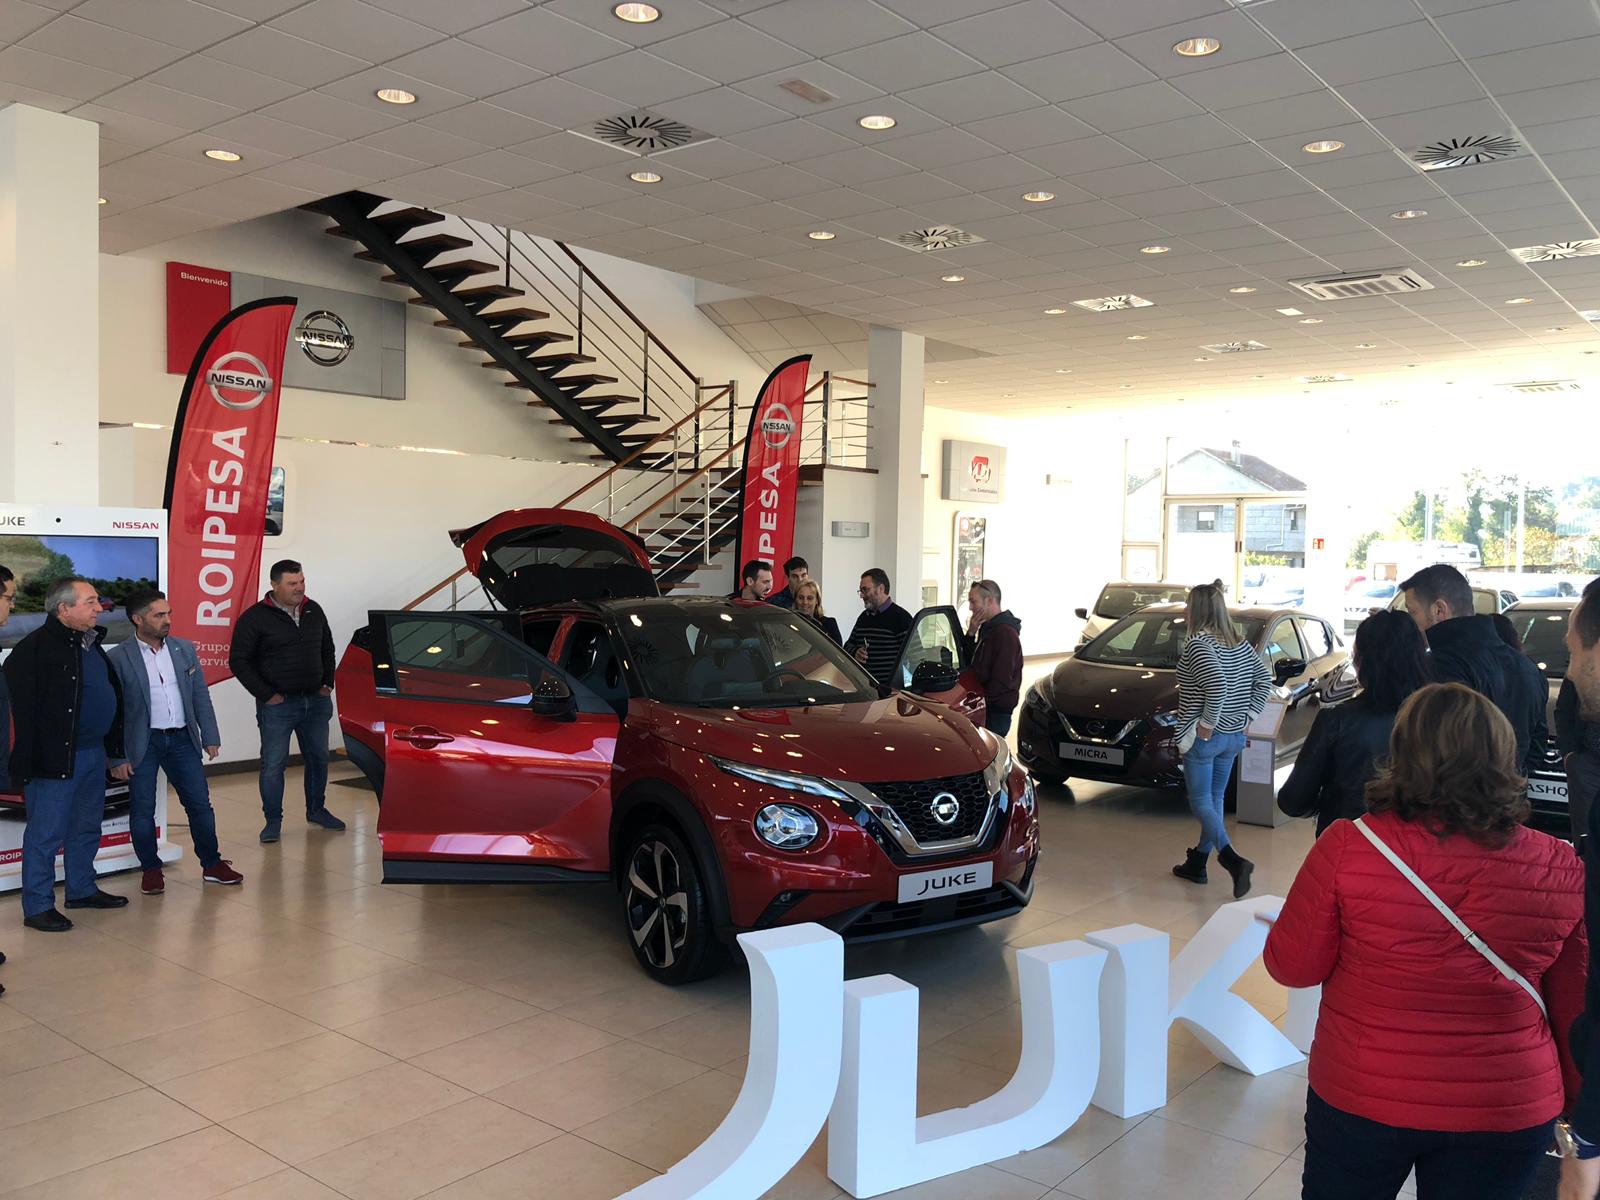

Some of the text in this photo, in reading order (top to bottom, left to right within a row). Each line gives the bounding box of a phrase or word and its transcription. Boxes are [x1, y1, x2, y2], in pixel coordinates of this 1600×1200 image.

[181, 272, 228, 287] Bienvenido
[303, 330, 350, 346] NISSAN
[211, 373, 266, 389] NISSAN
[763, 422, 791, 431] NSSAN
[112, 521, 159, 530] NISSAN
[196, 427, 248, 627] ROIPESA
[1074, 747, 1108, 760] MICRA
[917, 871, 977, 896] JUKE
